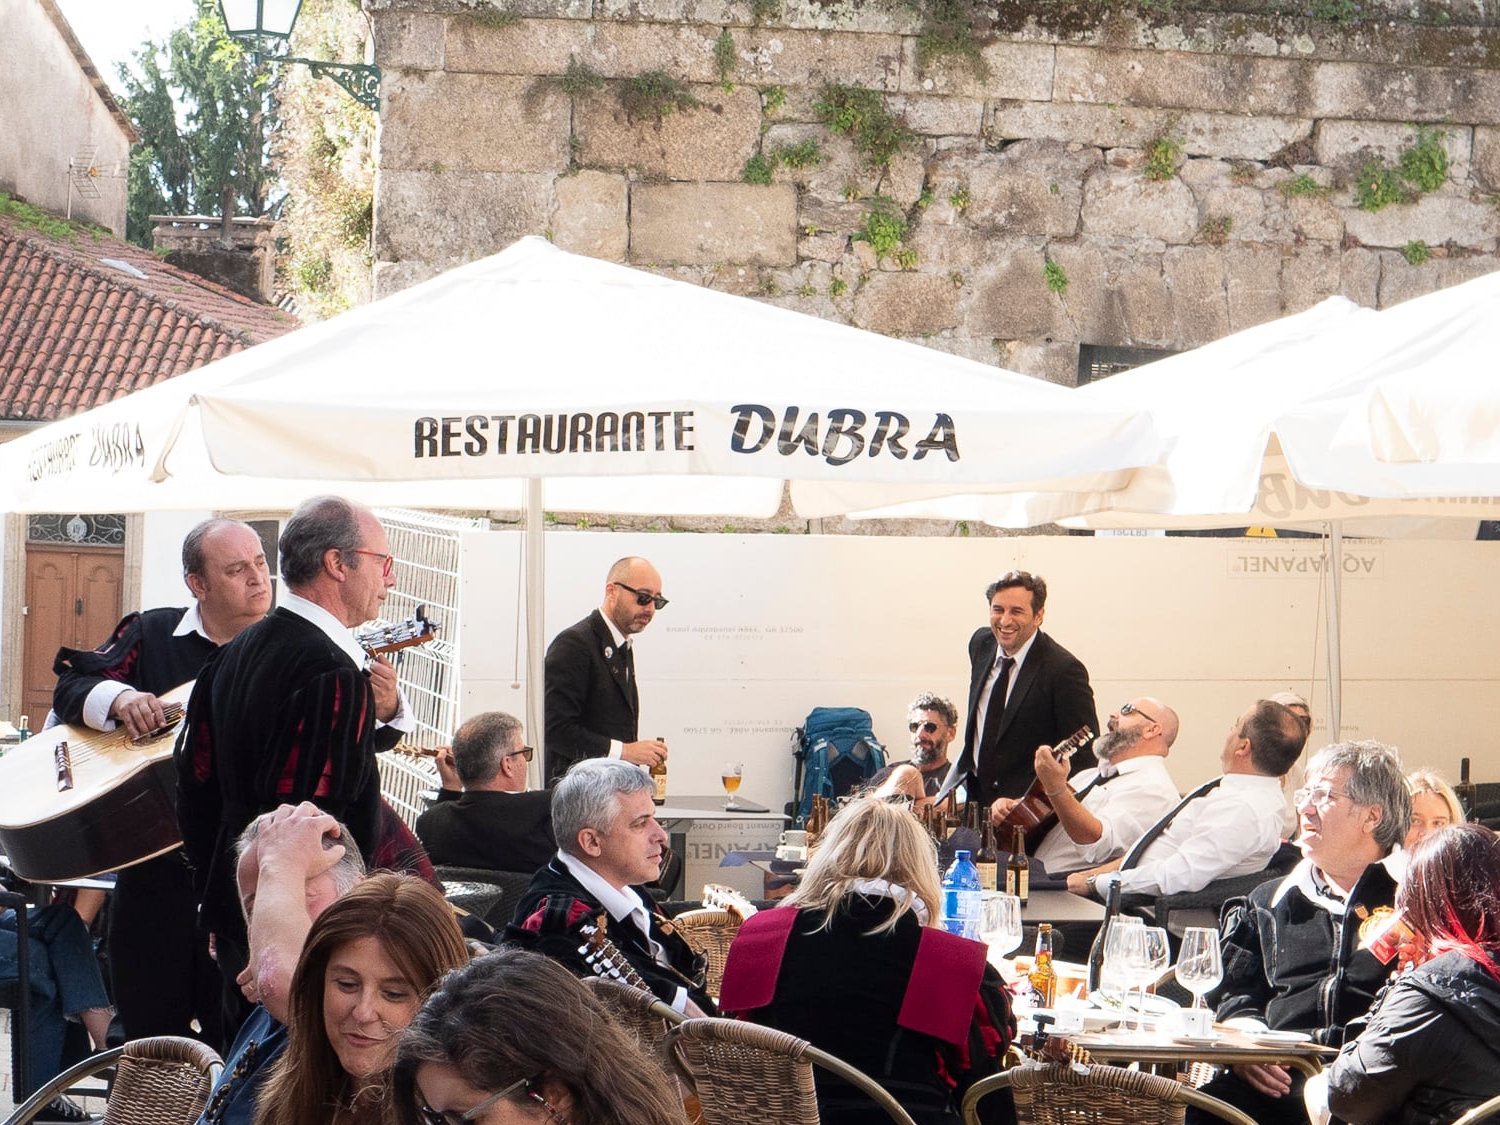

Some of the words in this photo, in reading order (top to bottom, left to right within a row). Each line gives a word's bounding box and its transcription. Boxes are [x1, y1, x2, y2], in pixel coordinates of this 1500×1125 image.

[414, 411, 695, 459] RESTAURANTE
[729, 403, 962, 466] DUBRA
[1237, 553, 1376, 573] AQAPANEL
